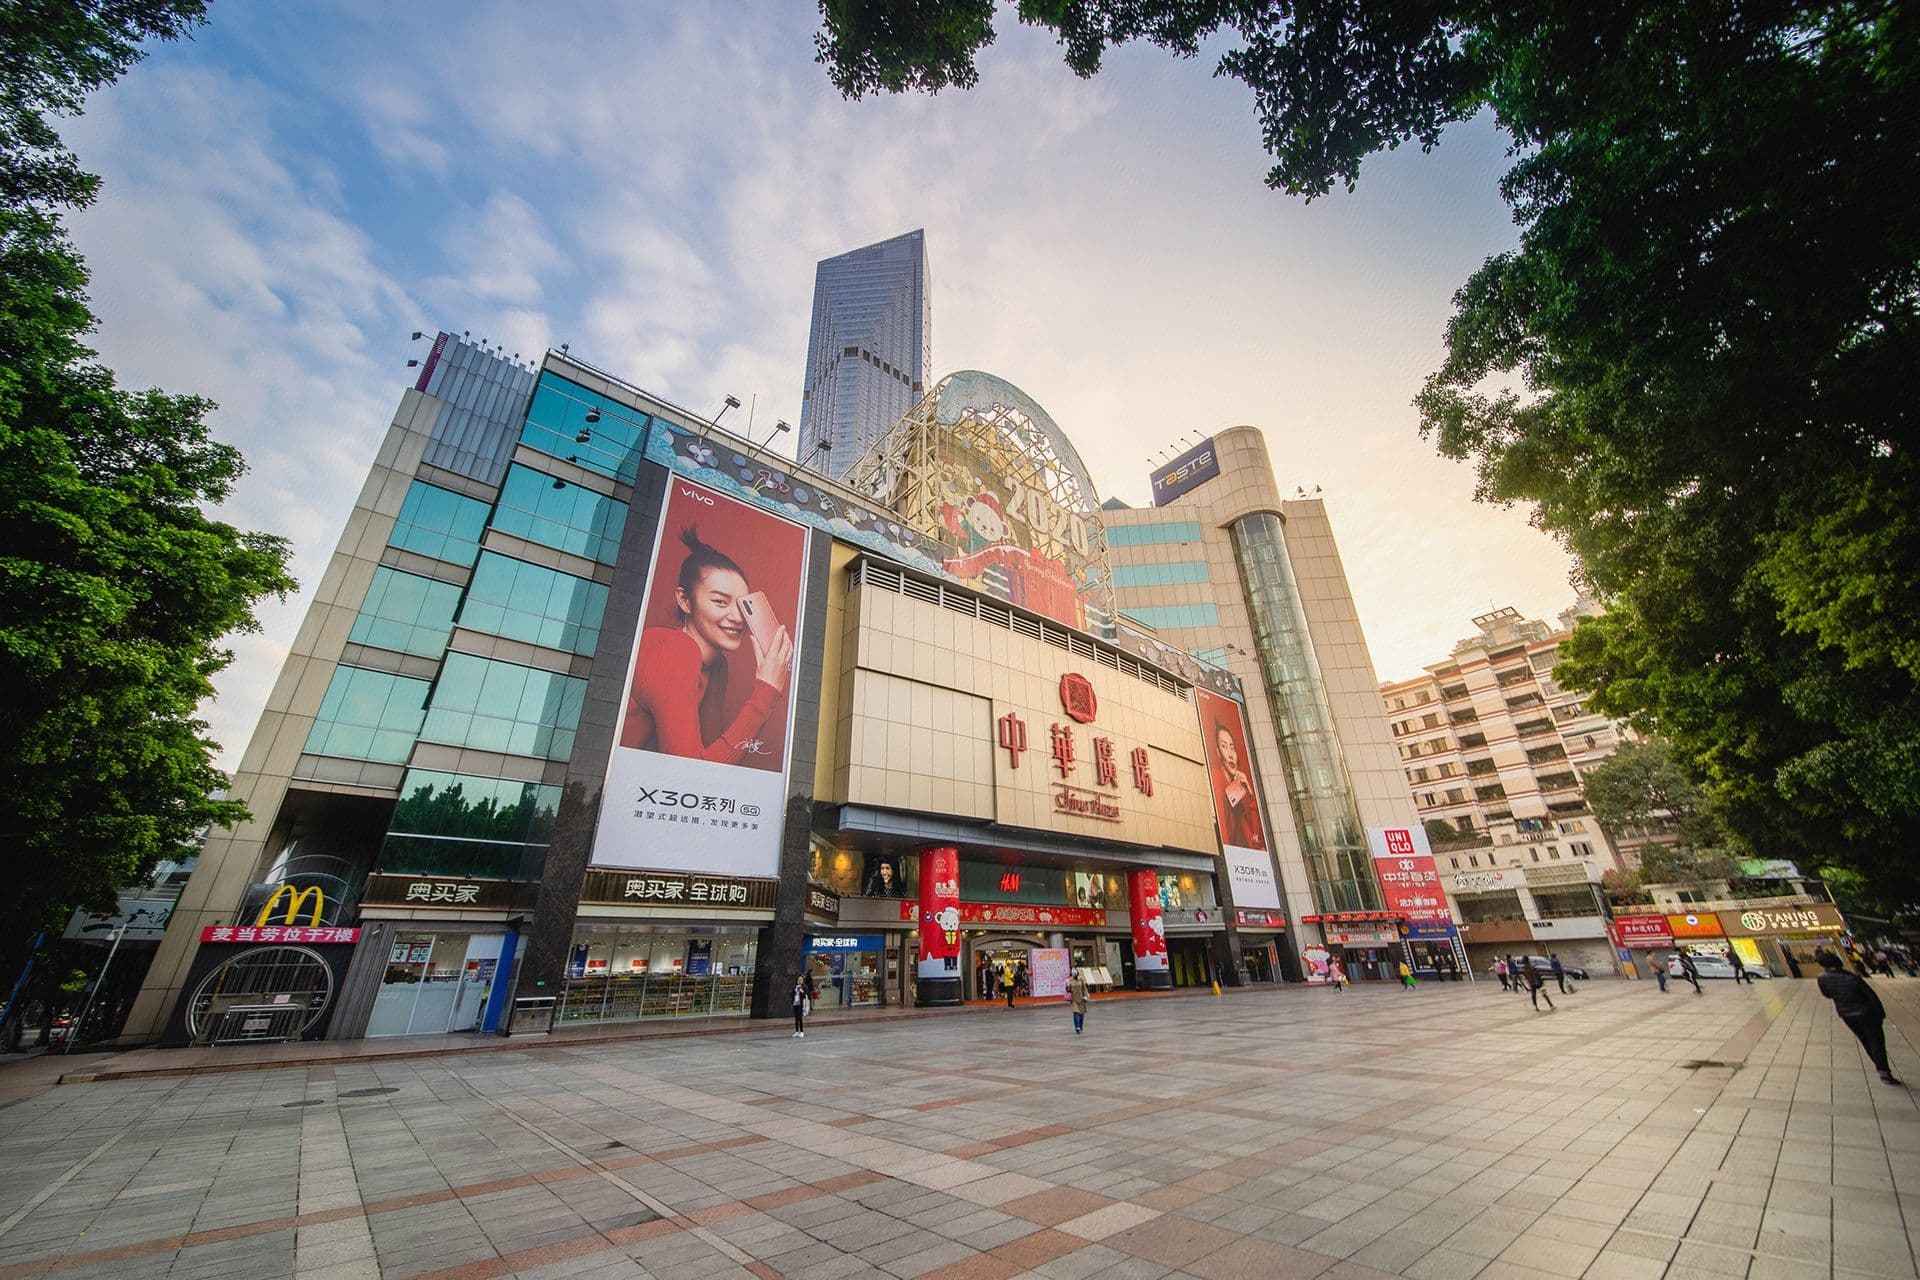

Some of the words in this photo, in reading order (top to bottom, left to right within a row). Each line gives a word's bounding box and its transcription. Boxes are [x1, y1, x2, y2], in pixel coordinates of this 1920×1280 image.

[681, 487, 715, 506] vivo
[1004, 475, 1089, 558] 2020
[636, 786, 736, 814] X30系列
[1387, 832, 1407, 842] UNI
[1390, 842, 1411, 853] QLO
[624, 879, 747, 903] 奥买家·全球购
[1000, 872, 1021, 893] H&M
[406, 883, 480, 903] 奥买家
[1765, 911, 1818, 925] TANING
[211, 927, 353, 943] 麦当劳位于7楼
